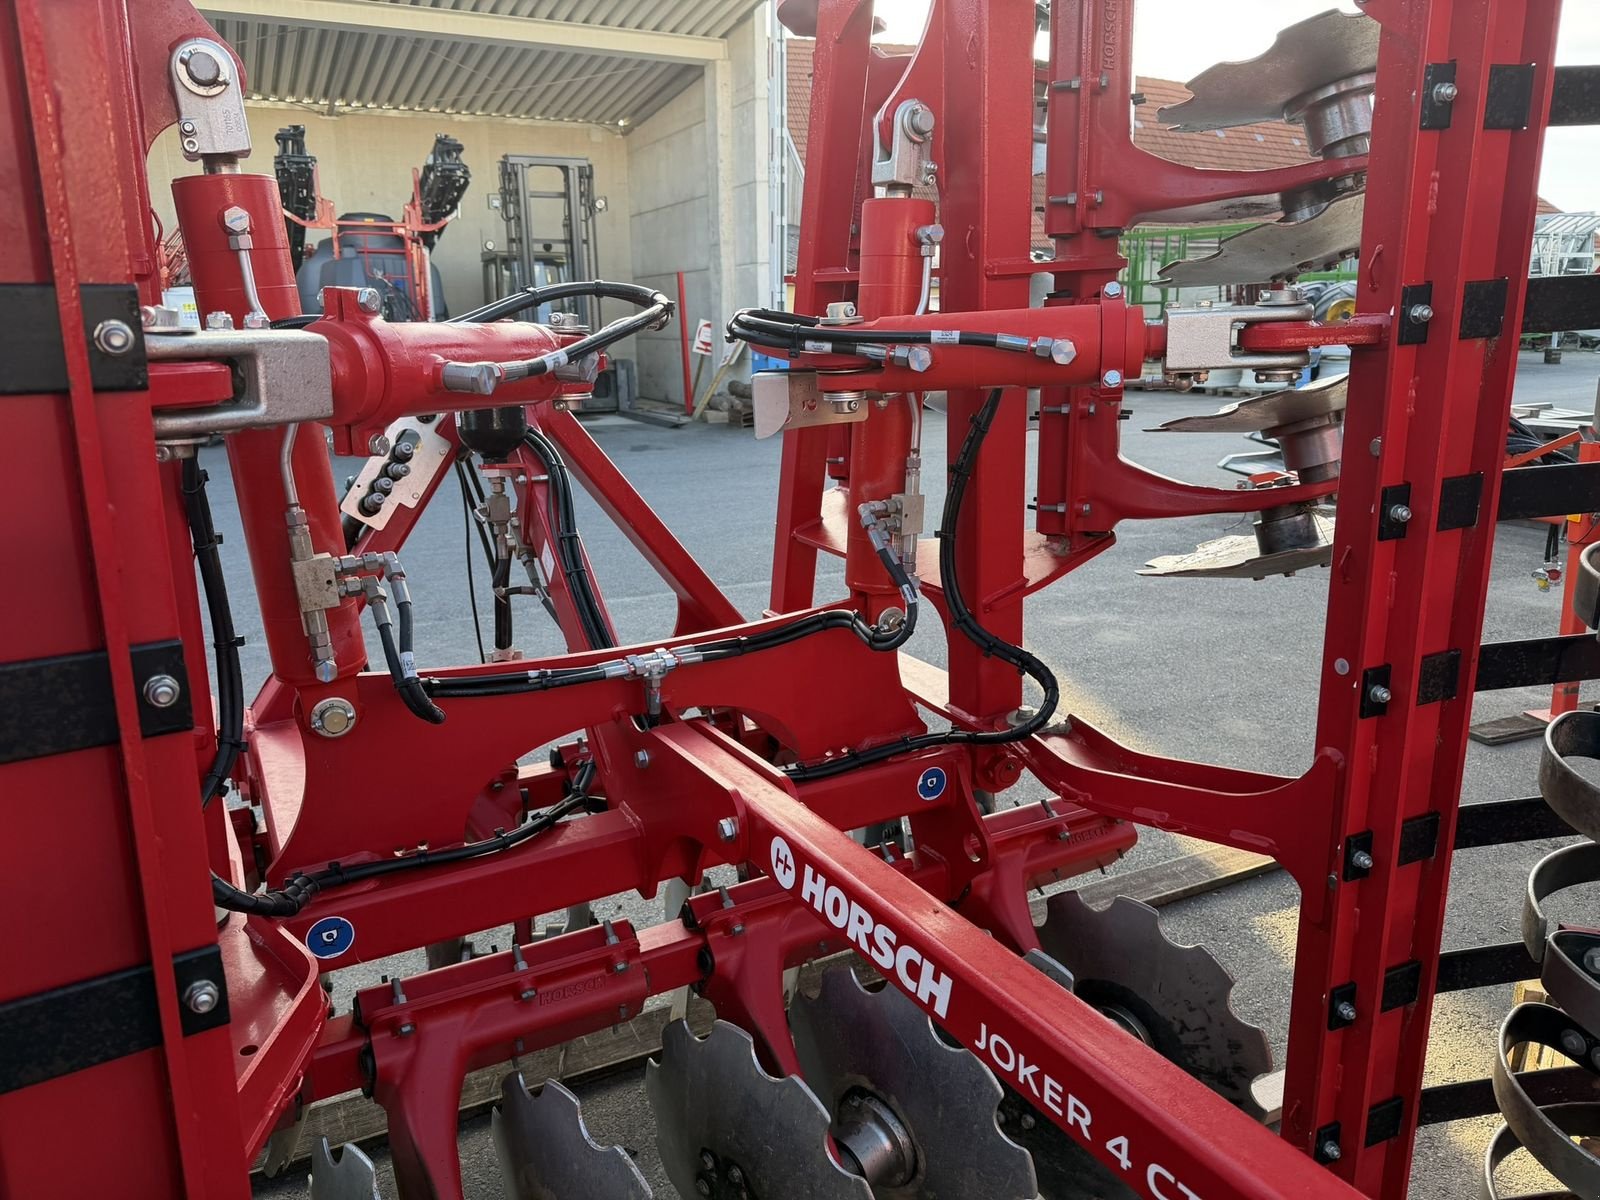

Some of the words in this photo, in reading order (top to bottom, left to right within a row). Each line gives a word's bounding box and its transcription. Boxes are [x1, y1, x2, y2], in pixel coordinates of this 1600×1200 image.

[801, 864, 953, 1019] HORSCH
[975, 1023, 1092, 1141] JOKER
[1106, 1136, 1132, 1170] 4
